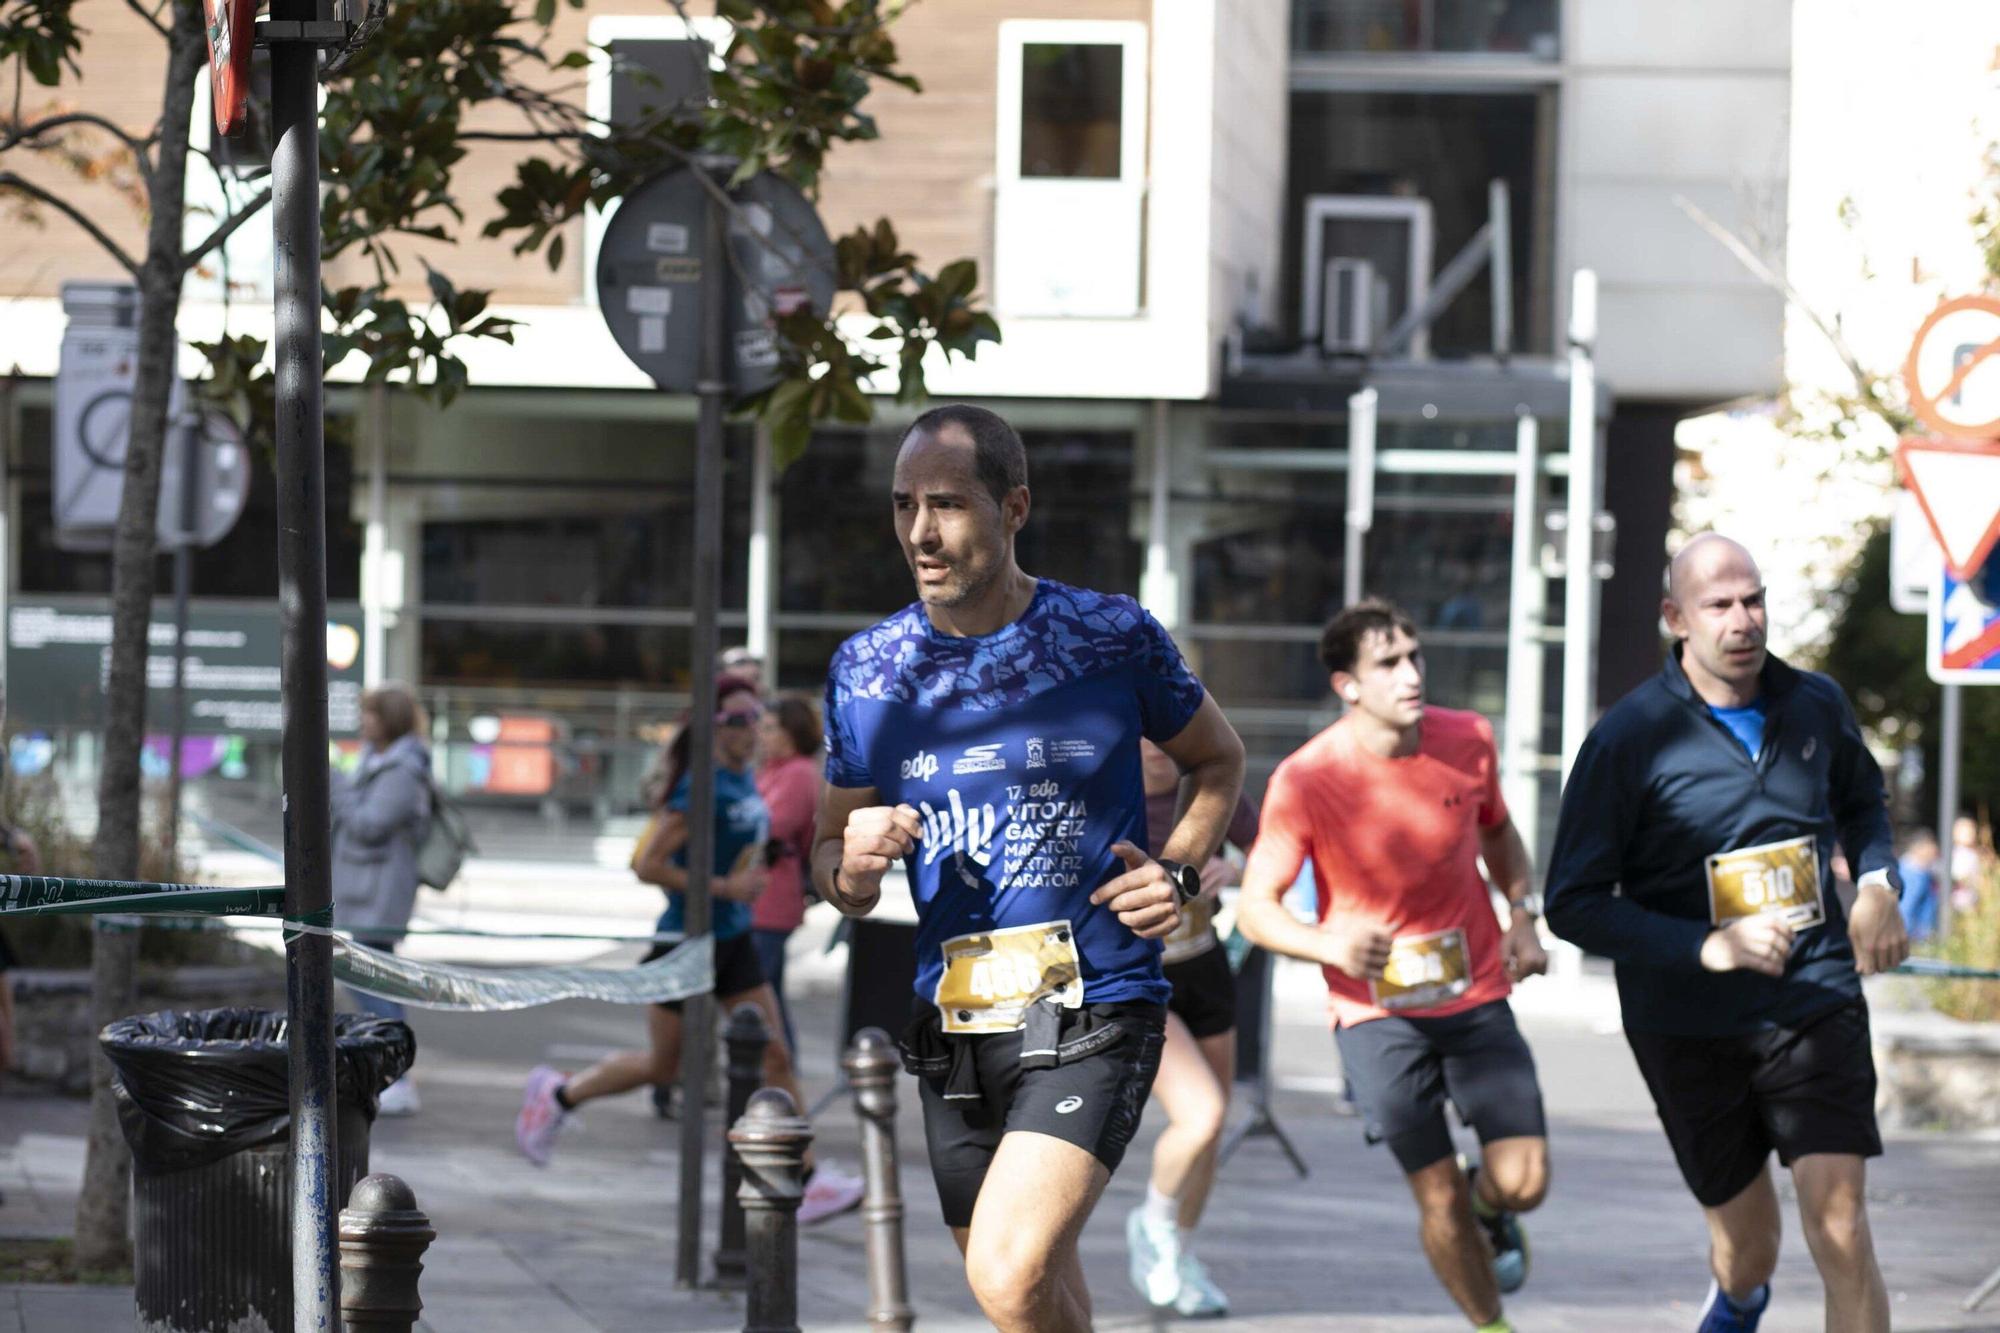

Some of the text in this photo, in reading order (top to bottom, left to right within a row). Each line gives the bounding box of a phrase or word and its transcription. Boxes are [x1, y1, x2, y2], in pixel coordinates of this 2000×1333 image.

[901, 750, 939, 782] edp
[1029, 779, 1059, 800] edp
[1006, 800, 1087, 821] VITORIA
[1005, 819, 1086, 840] GASTEIZ
